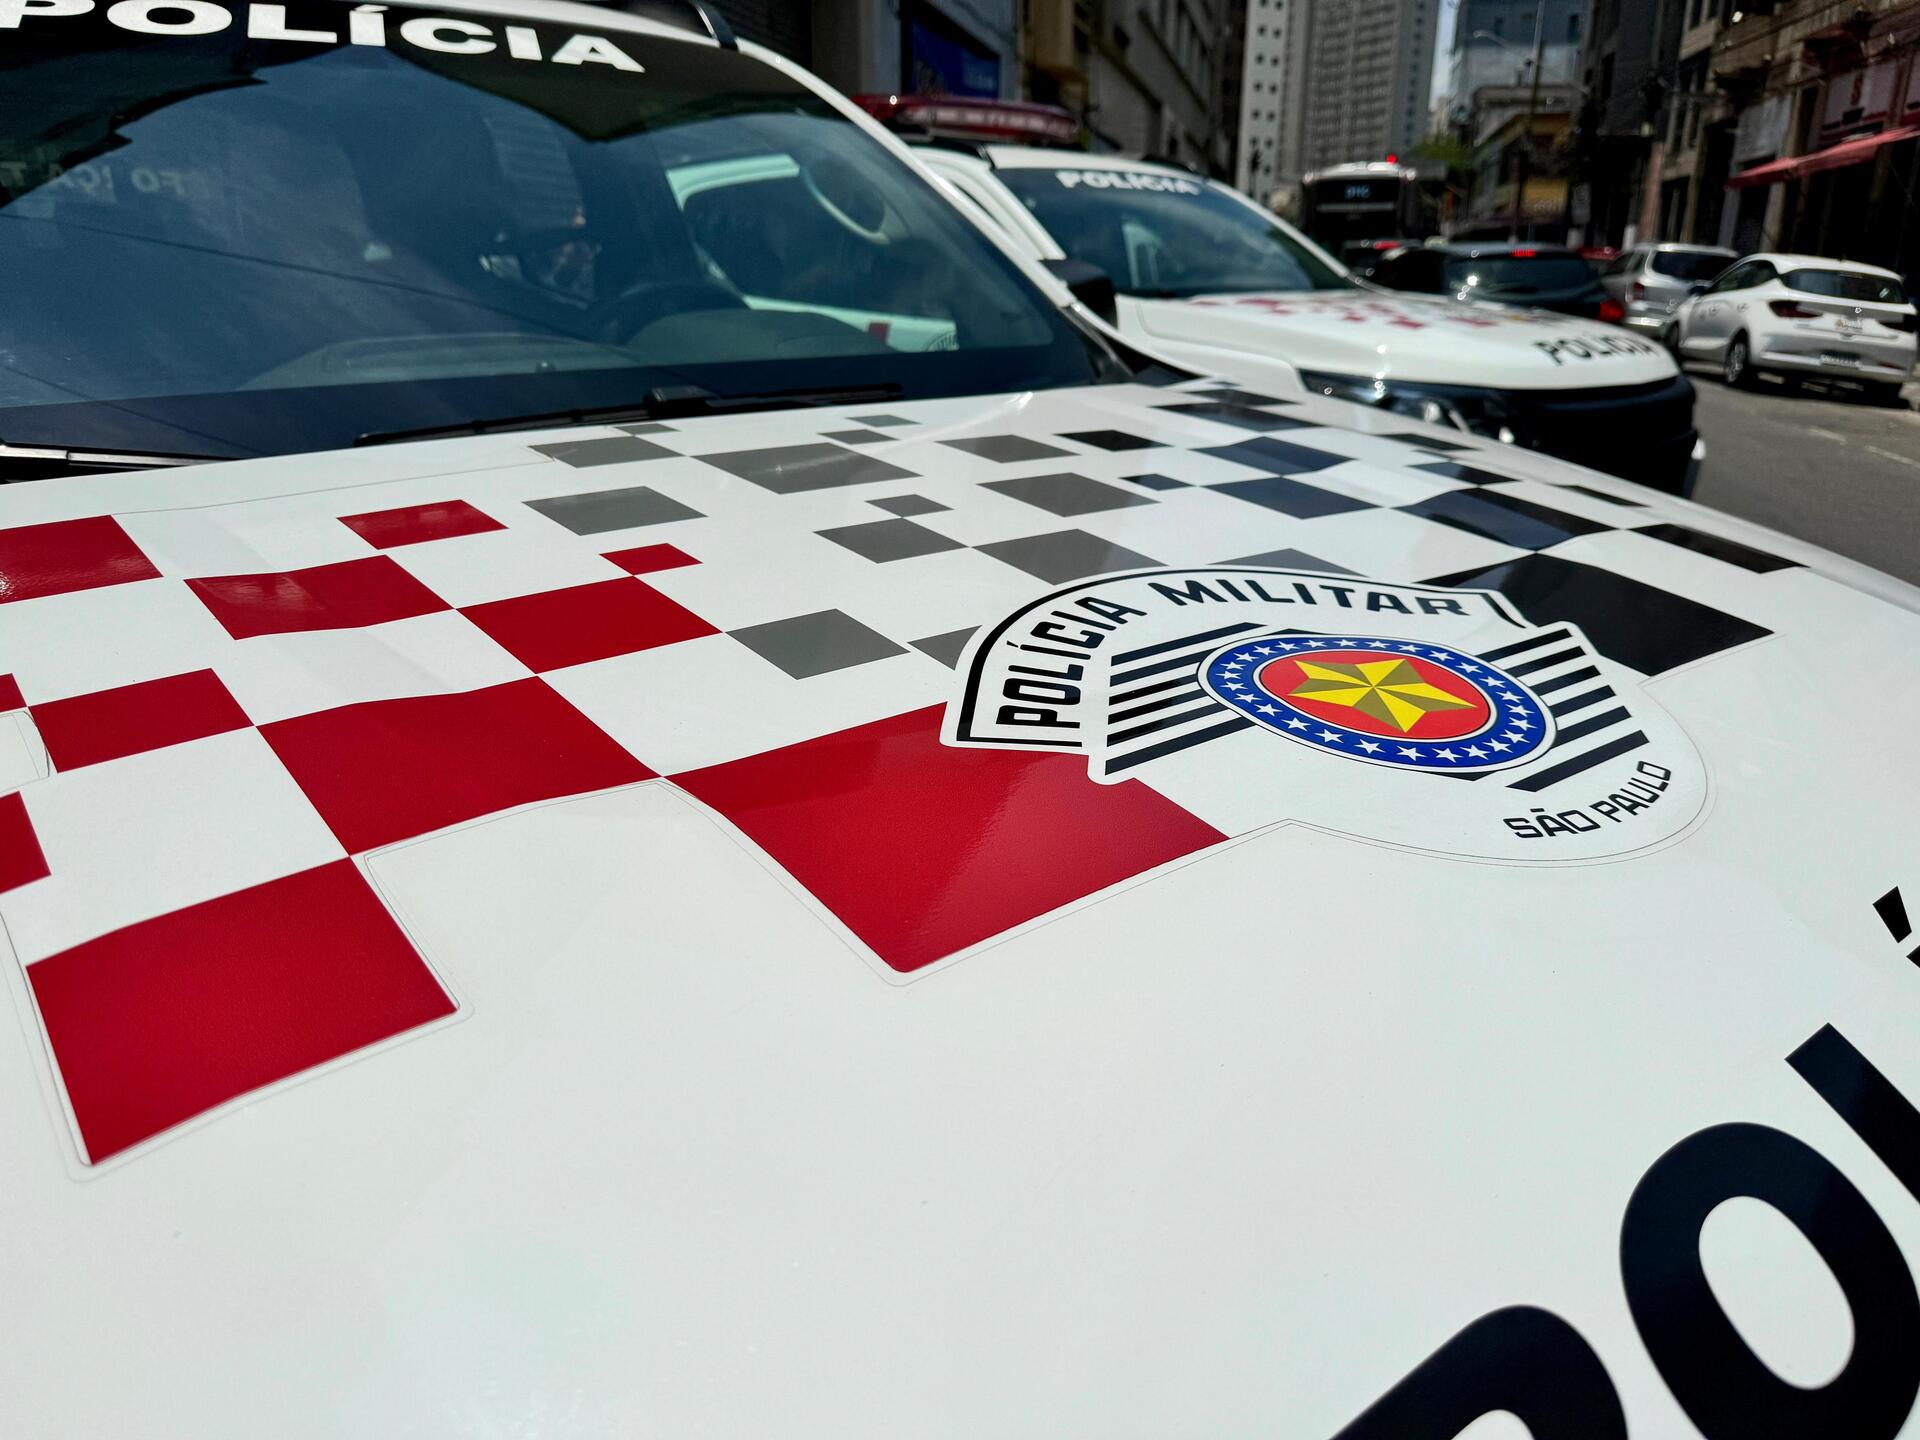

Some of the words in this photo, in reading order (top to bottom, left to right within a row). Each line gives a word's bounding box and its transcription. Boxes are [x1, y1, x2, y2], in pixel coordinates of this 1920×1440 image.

[996, 596, 1148, 729] POLÍCIA
[1147, 579, 1471, 616] MILITAR
[1502, 807, 1601, 839] SÃO
[1588, 760, 1672, 823] PAULO
